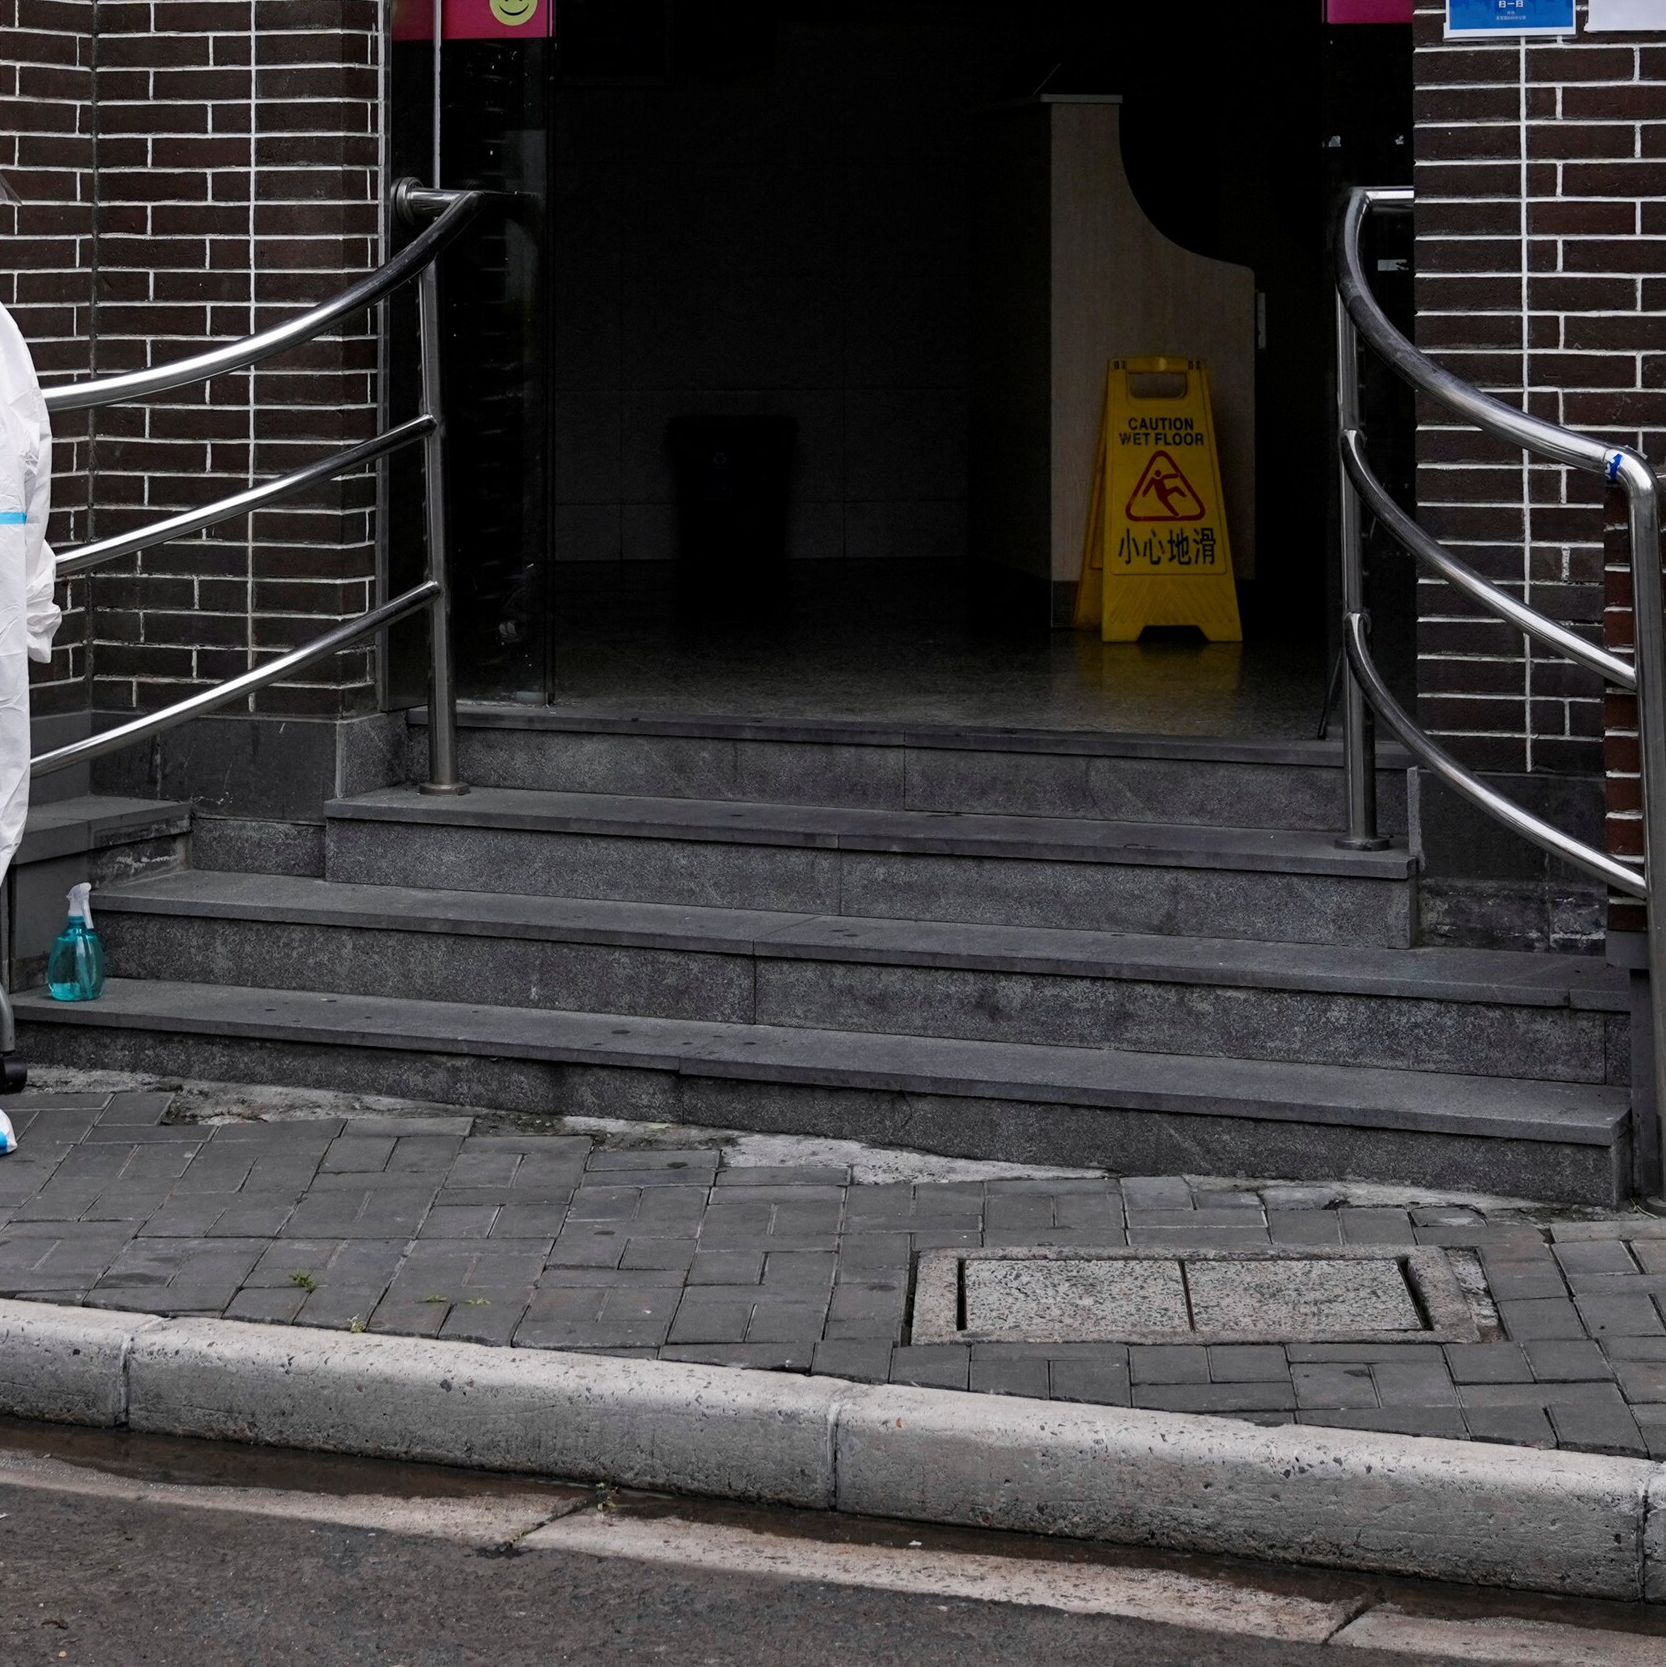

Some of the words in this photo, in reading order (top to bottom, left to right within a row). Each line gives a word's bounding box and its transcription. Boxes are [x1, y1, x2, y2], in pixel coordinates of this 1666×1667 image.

[1128, 416, 1195, 431] CAUTION
[1119, 433, 1151, 446] WET
[1154, 433, 1204, 446] FLOOR
[1118, 528, 1216, 565] 小心地滑
